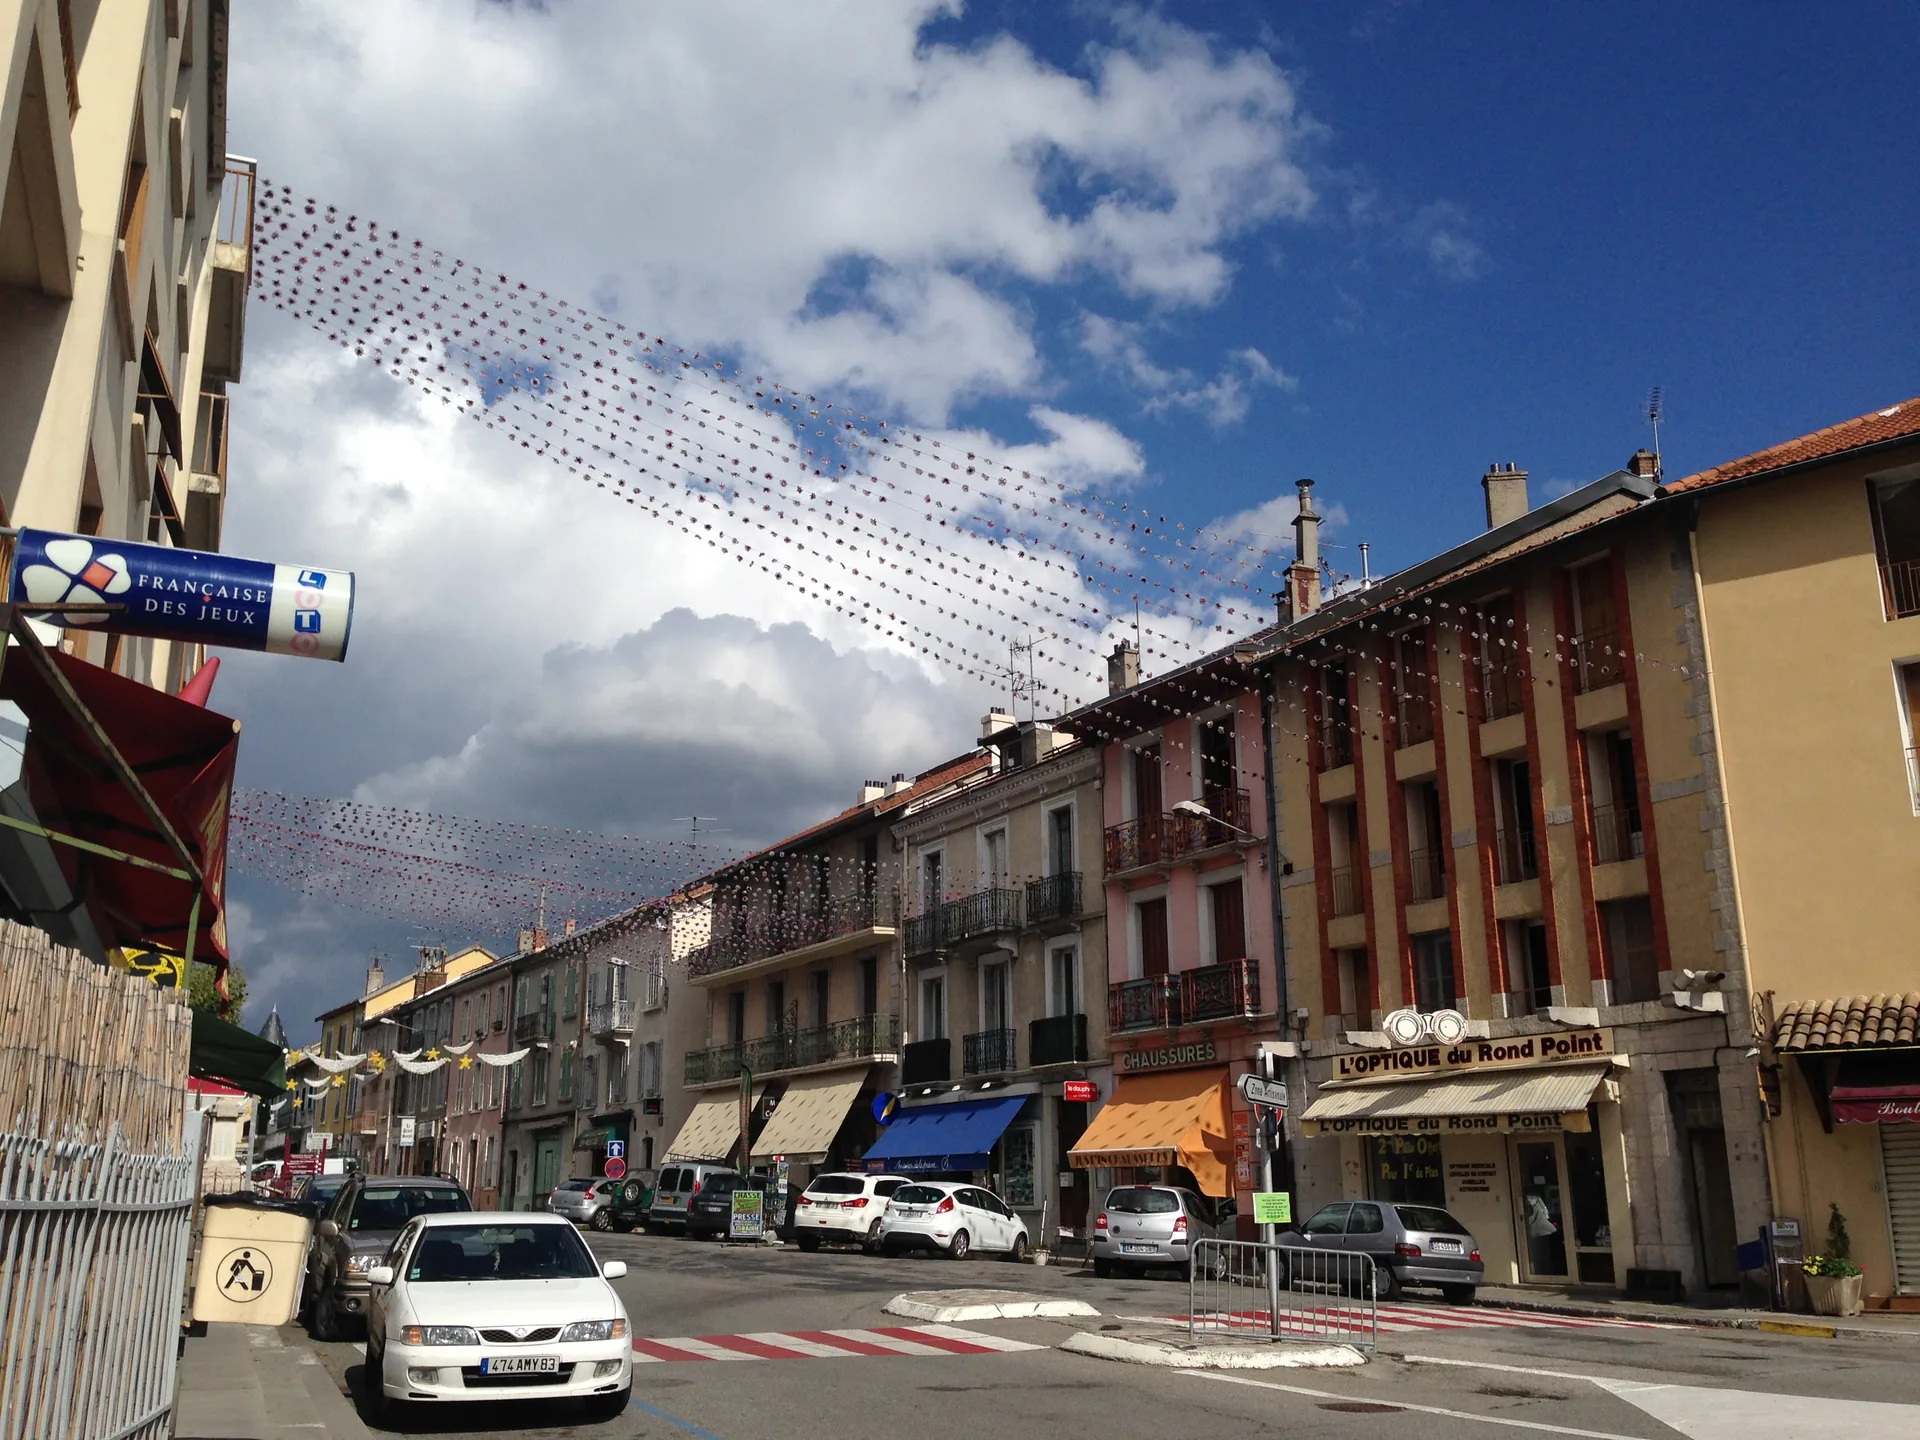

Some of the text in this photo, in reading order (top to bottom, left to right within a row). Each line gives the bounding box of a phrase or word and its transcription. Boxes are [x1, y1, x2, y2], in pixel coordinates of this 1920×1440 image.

[145, 598, 255, 624] DES JEUX
[290, 570, 327, 654] LOTO
[1122, 1043, 1215, 1069] CHAUSSURES
[1340, 1032, 1603, 1074] L'OPTIQUE du Rond Point
[1251, 1083, 1263, 1096] Zone
[1320, 1118, 1409, 1132] L'OPTIQUE
[1417, 1116, 1440, 1130] du
[1448, 1115, 1498, 1129] Rond
[1508, 1112, 1562, 1128] Point
[492, 1358, 556, 1372] 474 AMY 83
